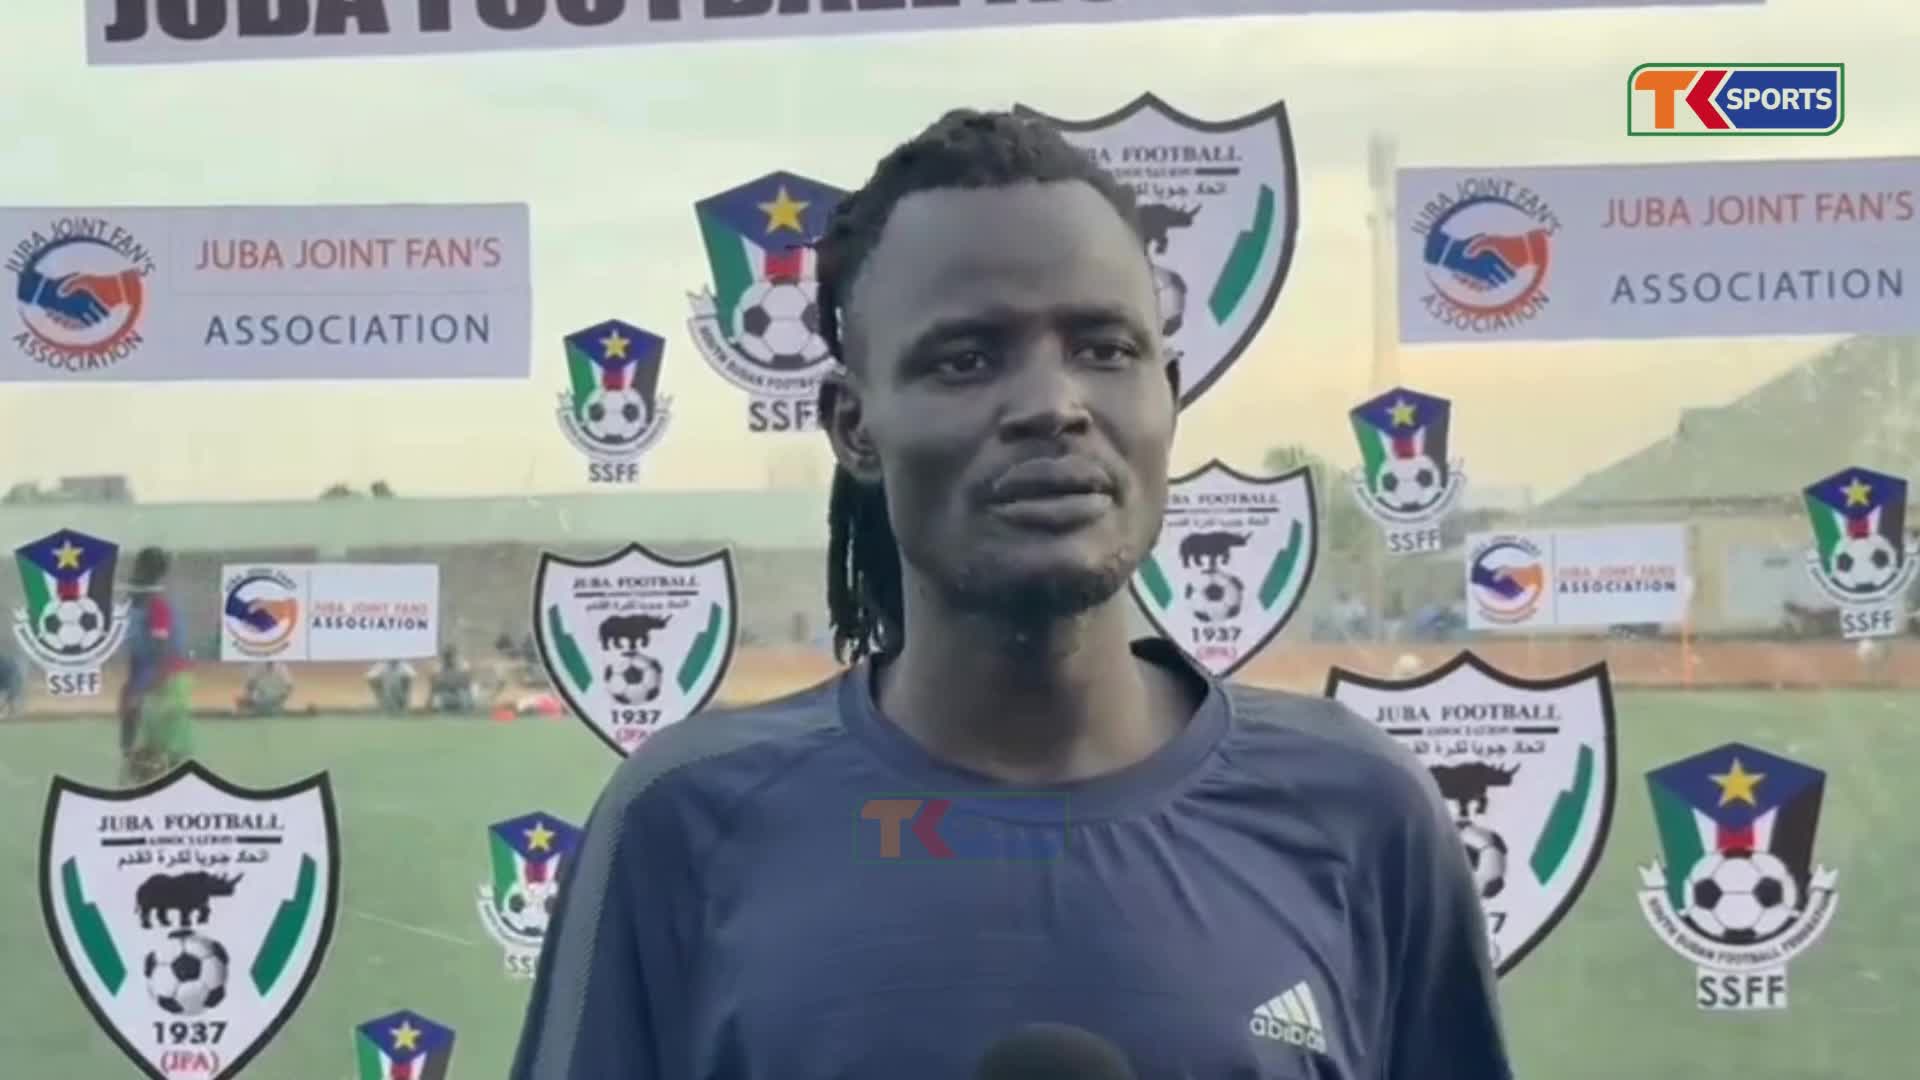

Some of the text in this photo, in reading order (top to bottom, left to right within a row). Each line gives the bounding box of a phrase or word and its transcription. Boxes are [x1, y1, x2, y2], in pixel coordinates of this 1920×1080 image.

[1122, 145, 1243, 162] FOOTBALL
[1410, 191, 1454, 235] JUBA
[1456, 177, 1515, 199] JOINT
[1601, 191, 1914, 229] JUBA JOINT FAN'S
[4, 230, 48, 273] JUBA
[50, 217, 108, 239] JOINT
[195, 237, 501, 270] JUBA JOINT FAN'S
[1611, 268, 1903, 304] ASSOCIATION
[1420, 289, 1550, 334] ASSOCIATION
[204, 313, 490, 346] ASSOCIATION
[12, 329, 144, 372] ASSOCIATION
[749, 401, 816, 431] SSF
[589, 463, 638, 482] SSFF
[1390, 529, 1439, 551] SSFF
[617, 575, 700, 588] FOOTBALL
[1558, 580, 1677, 594] ASSOCIATION
[312, 616, 428, 630] ASSOCIATION
[1843, 610, 1893, 633] SSFF
[1192, 626, 1242, 643] 1937
[50, 673, 99, 694] SSFF
[611, 709, 662, 725] 1937
[1376, 704, 1561, 722] JUBA FOOTBALL
[98, 814, 284, 832] JUBA FOOTBALL
[507, 955, 536, 974] SS
[1699, 975, 1784, 1007] SSFF
[153, 1021, 228, 1044] 1937
